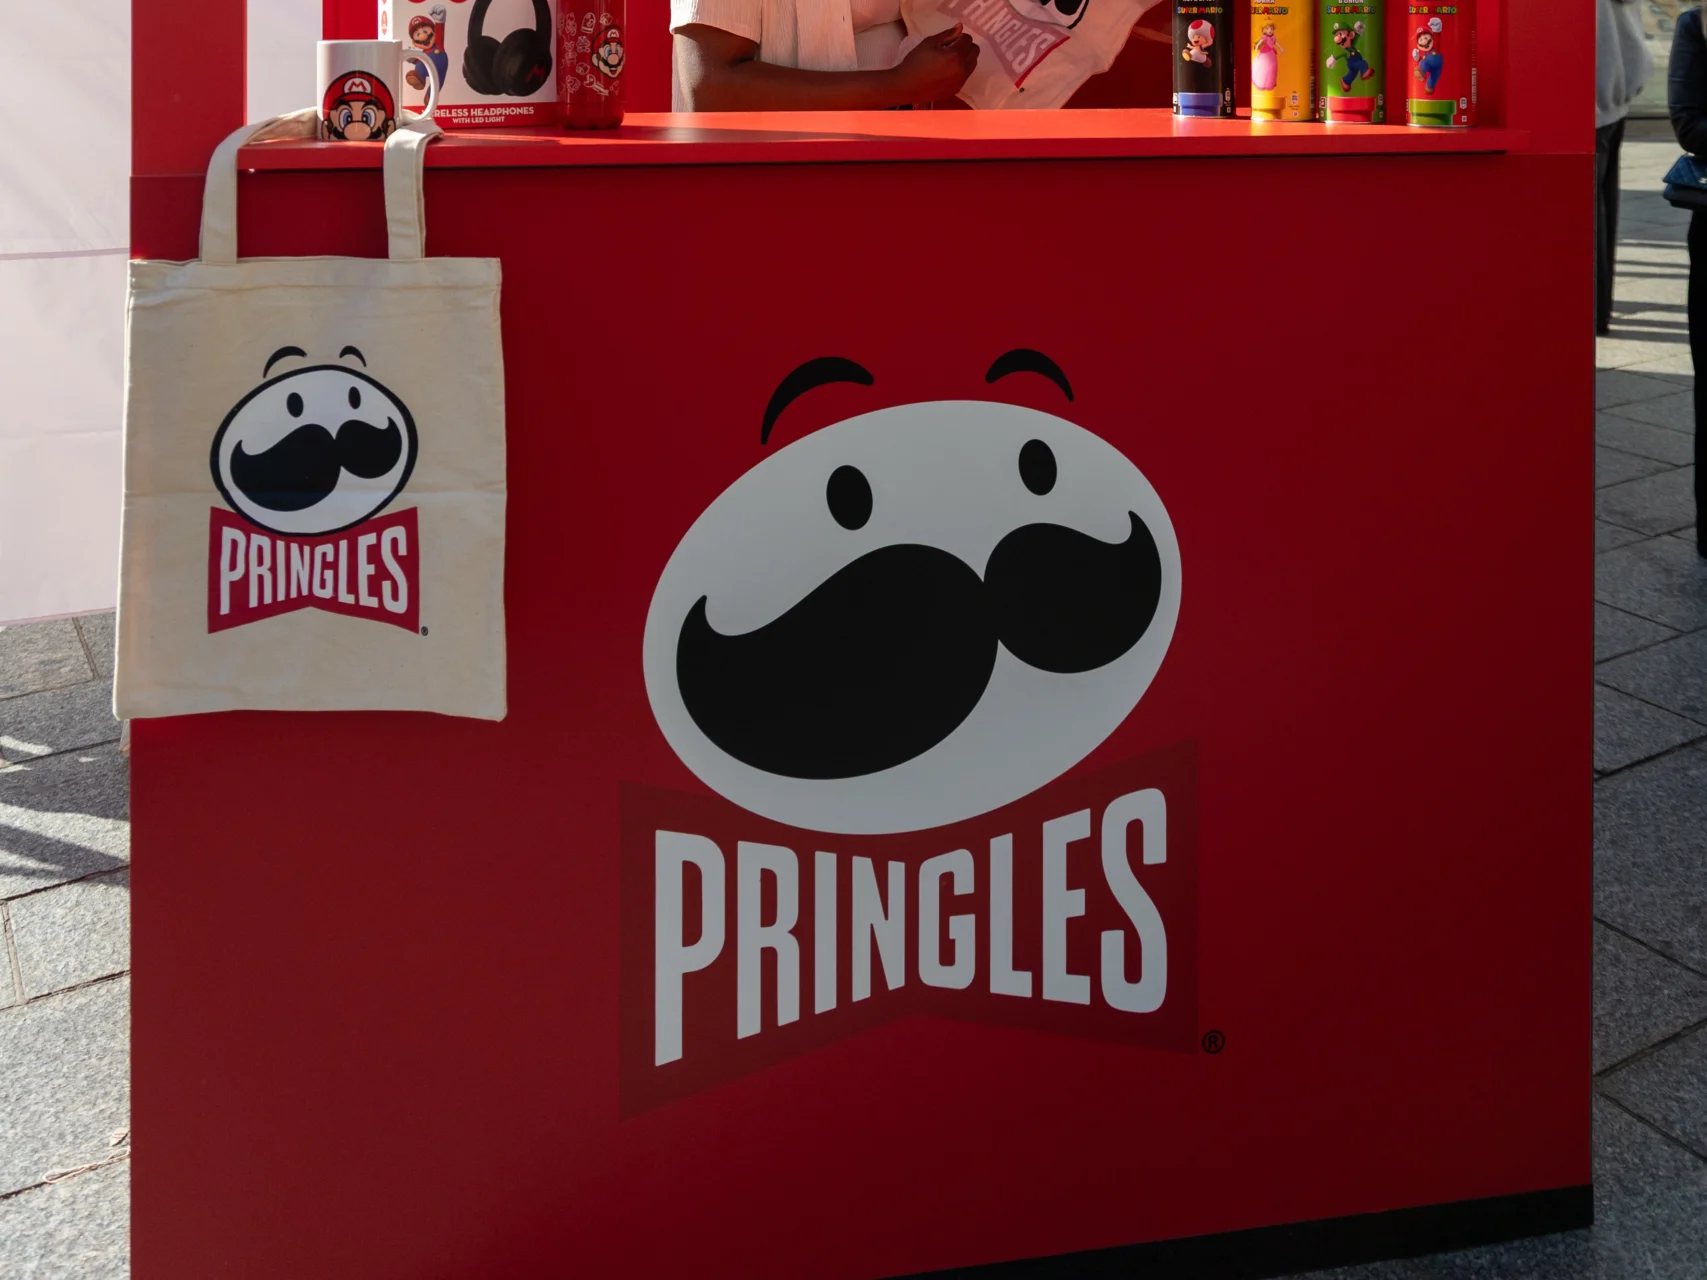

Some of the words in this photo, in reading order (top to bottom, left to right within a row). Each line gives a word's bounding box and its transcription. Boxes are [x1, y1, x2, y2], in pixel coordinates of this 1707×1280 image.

[1263, 7, 1288, 15] MARIO
[1326, 5, 1351, 14] SUPER
[1351, 5, 1376, 15] MARIO
[1408, 5, 1429, 14] SUPER
[1429, 6, 1457, 14] MARIO
[422, 108, 469, 118] RELESS
[470, 107, 534, 116] HEADPHONES
[219, 525, 408, 615] PRINGLES
[655, 787, 1168, 1067] PRINGLES
